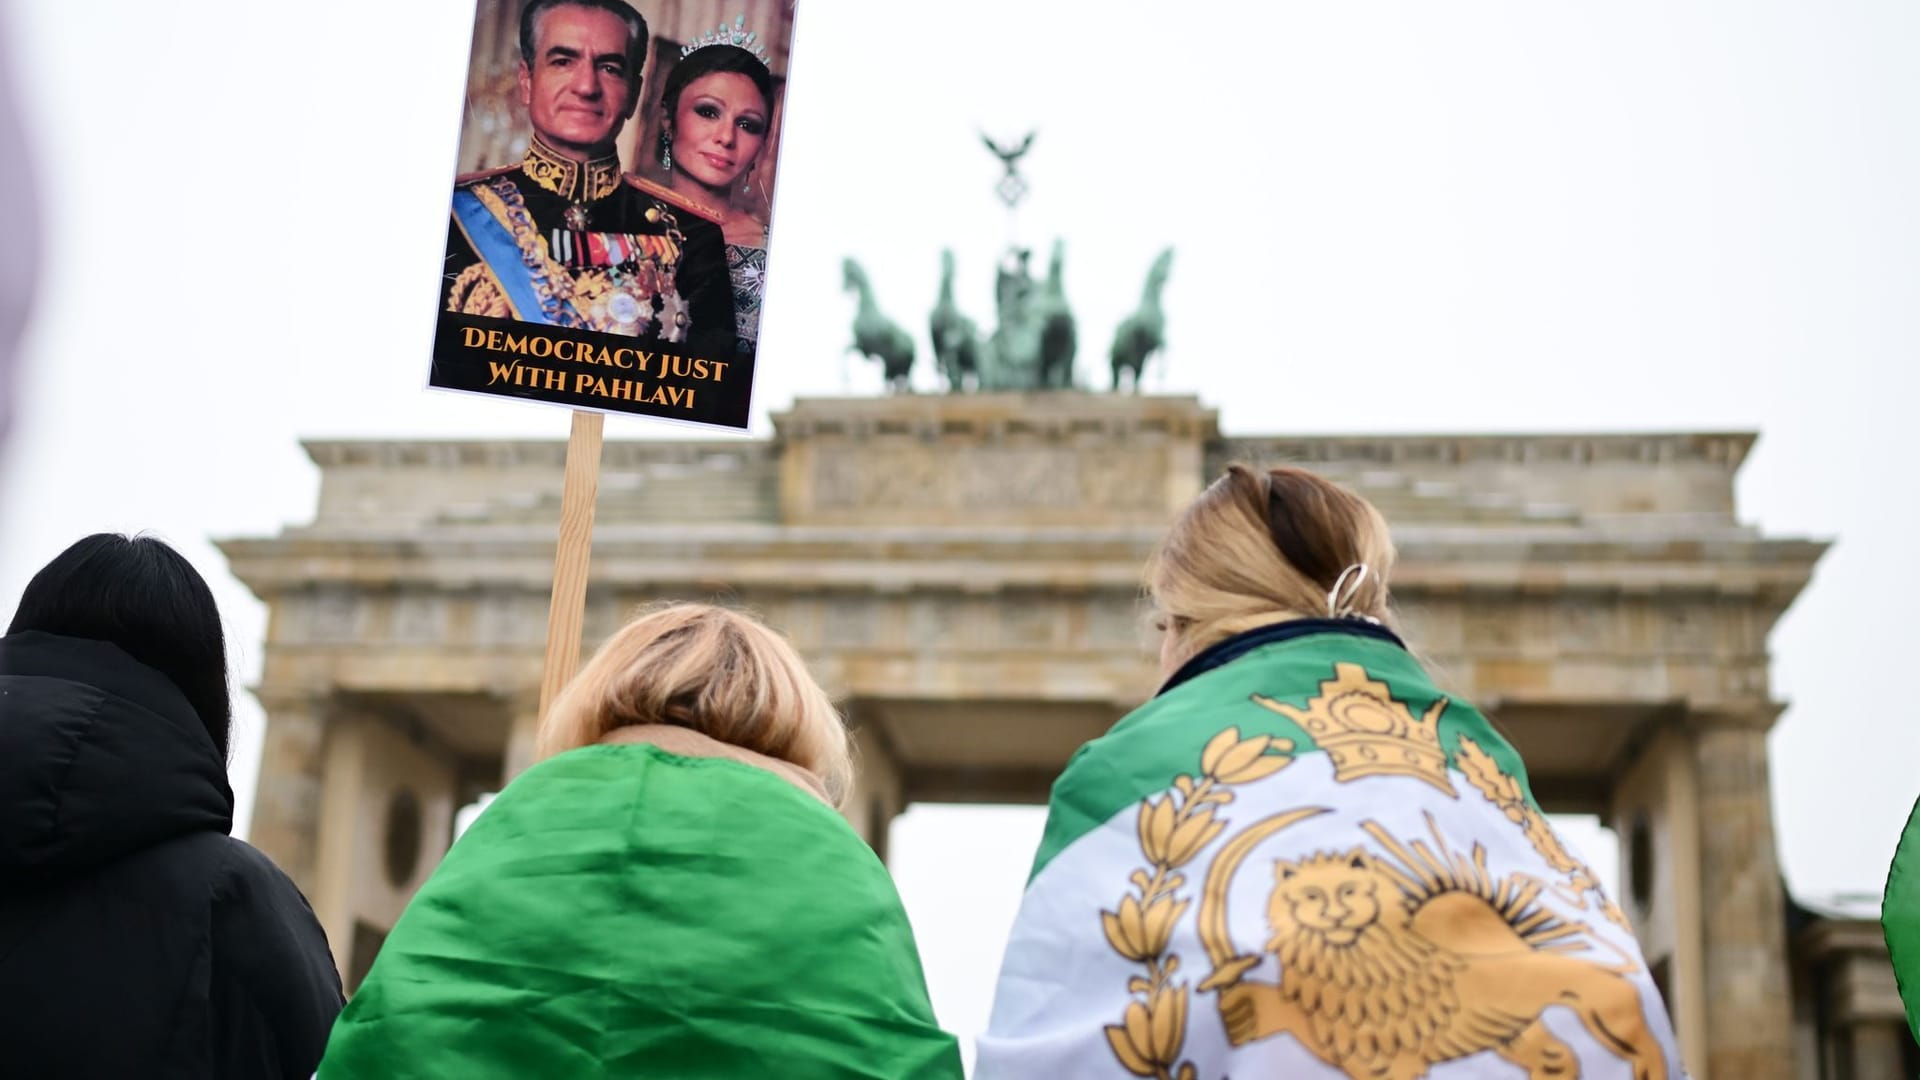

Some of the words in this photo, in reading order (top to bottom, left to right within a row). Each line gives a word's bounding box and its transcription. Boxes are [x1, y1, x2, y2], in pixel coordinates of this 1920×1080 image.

[462, 327, 654, 371] DEMOCRACY
[657, 354, 729, 382] JUST
[488, 359, 567, 391] WITH
[575, 374, 695, 409] PAHLAVI
